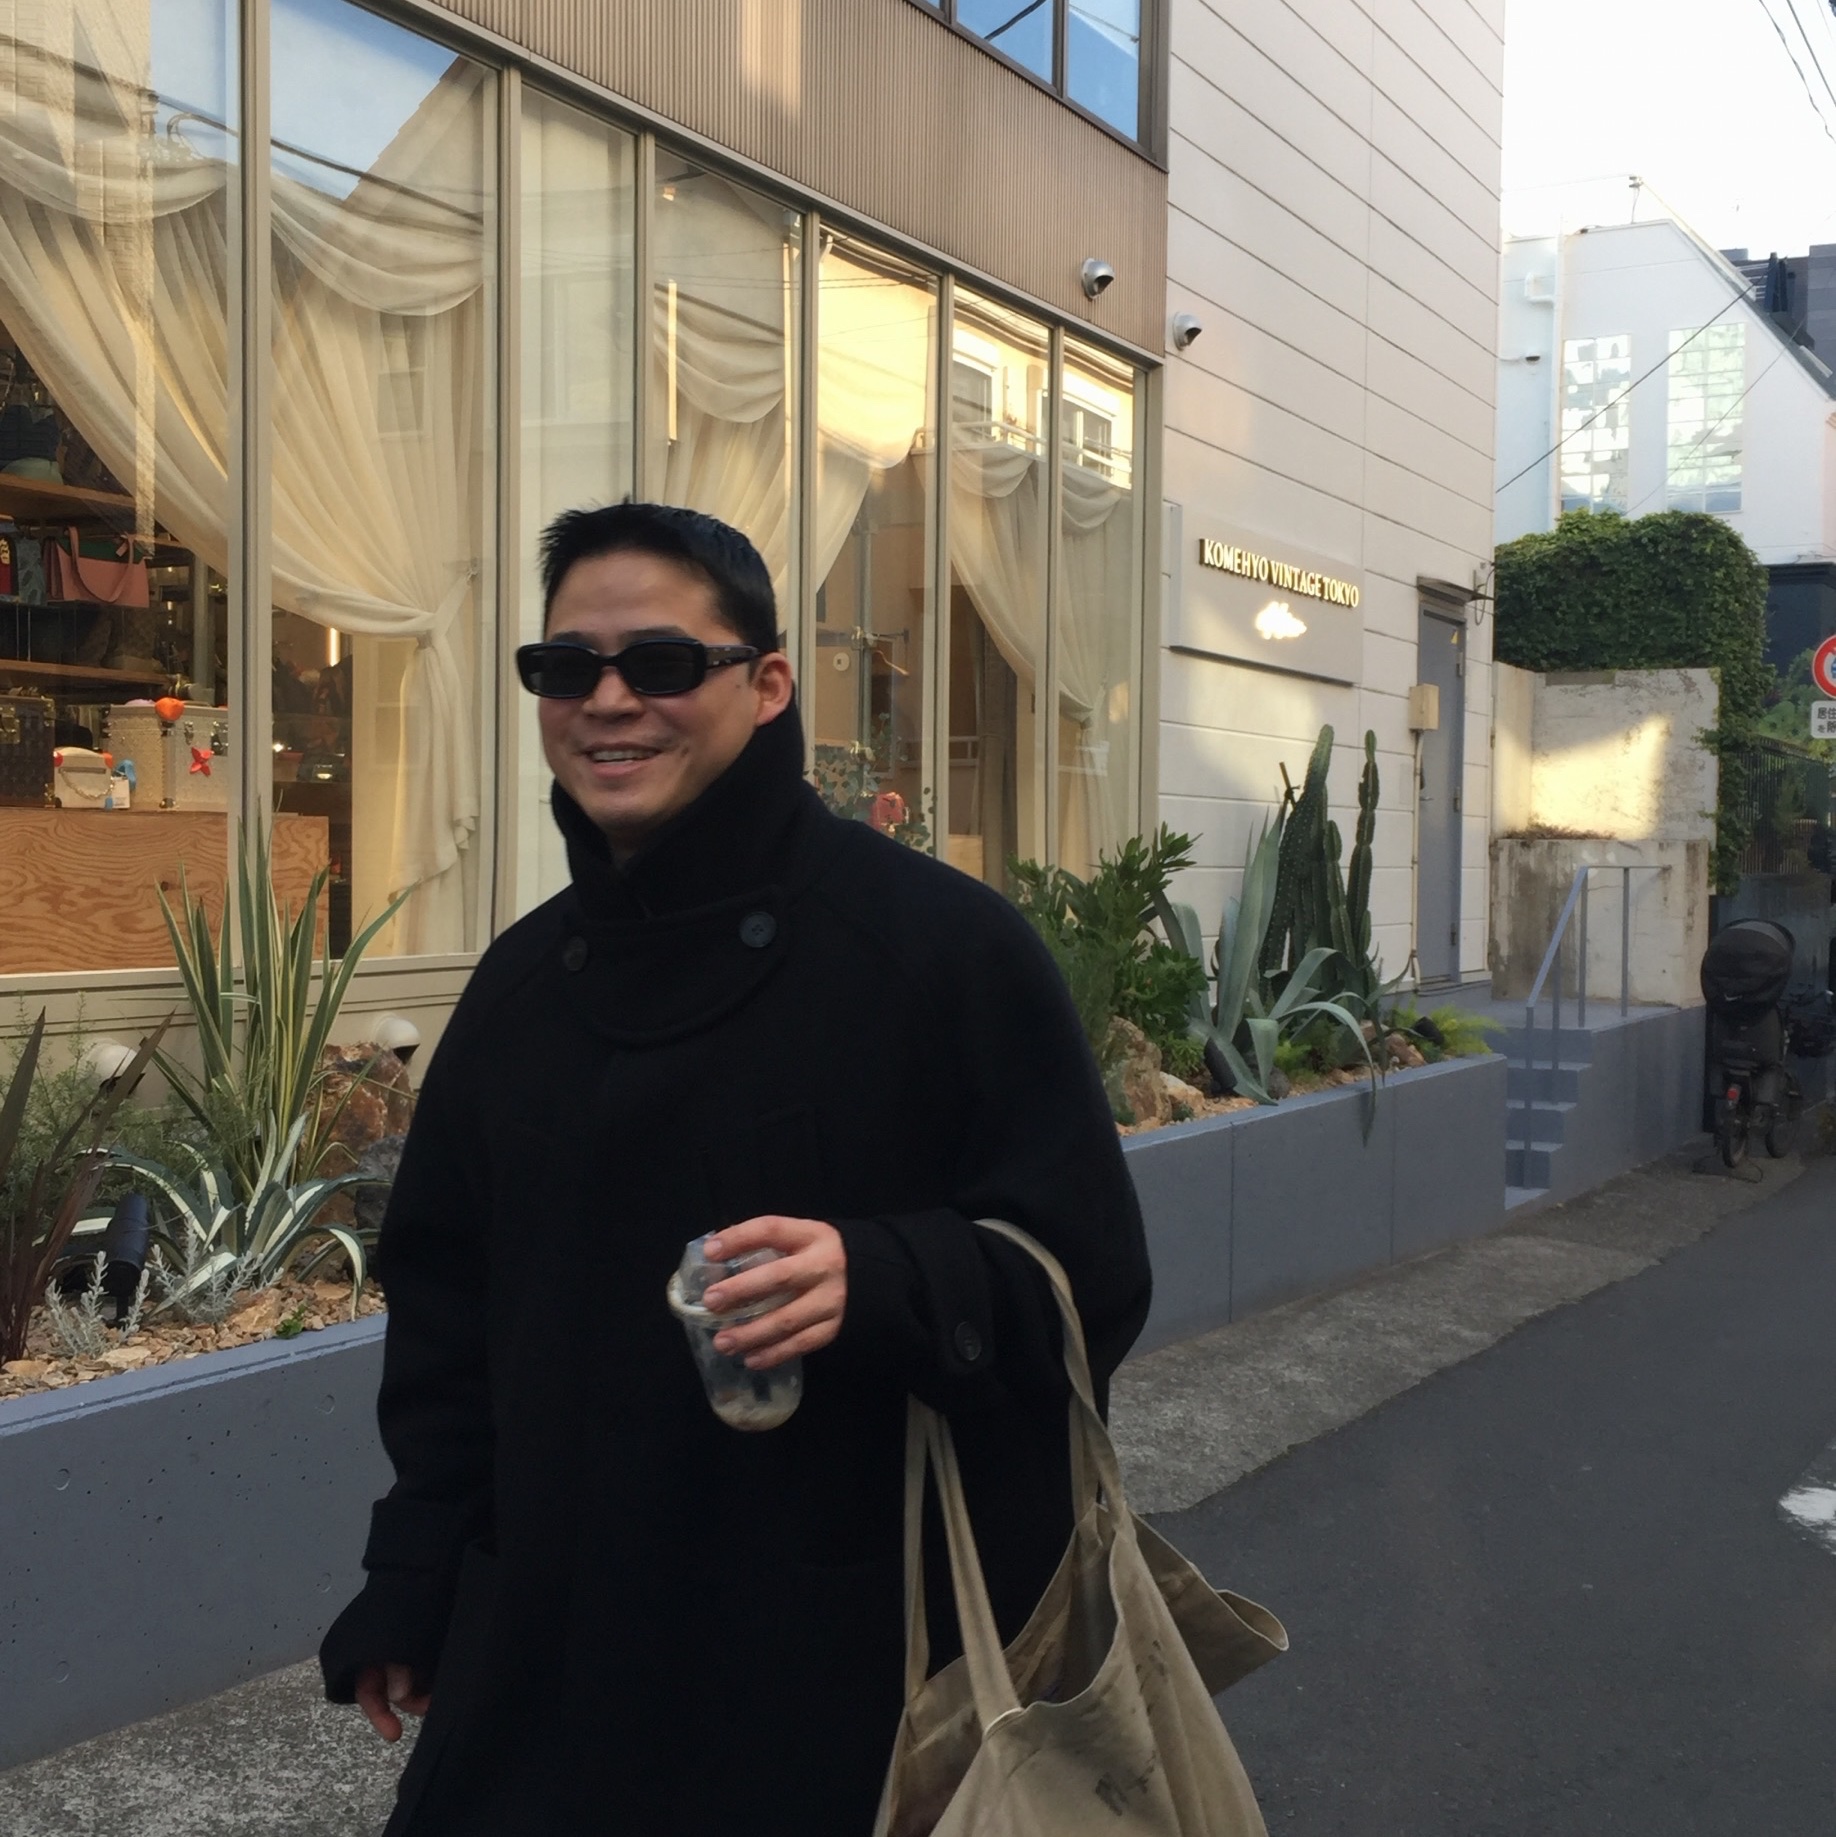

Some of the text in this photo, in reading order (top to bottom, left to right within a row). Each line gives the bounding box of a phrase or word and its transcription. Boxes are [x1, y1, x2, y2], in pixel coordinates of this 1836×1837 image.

[1203, 538, 1359, 608] KOMEHYO VINTAGE TOKYO
